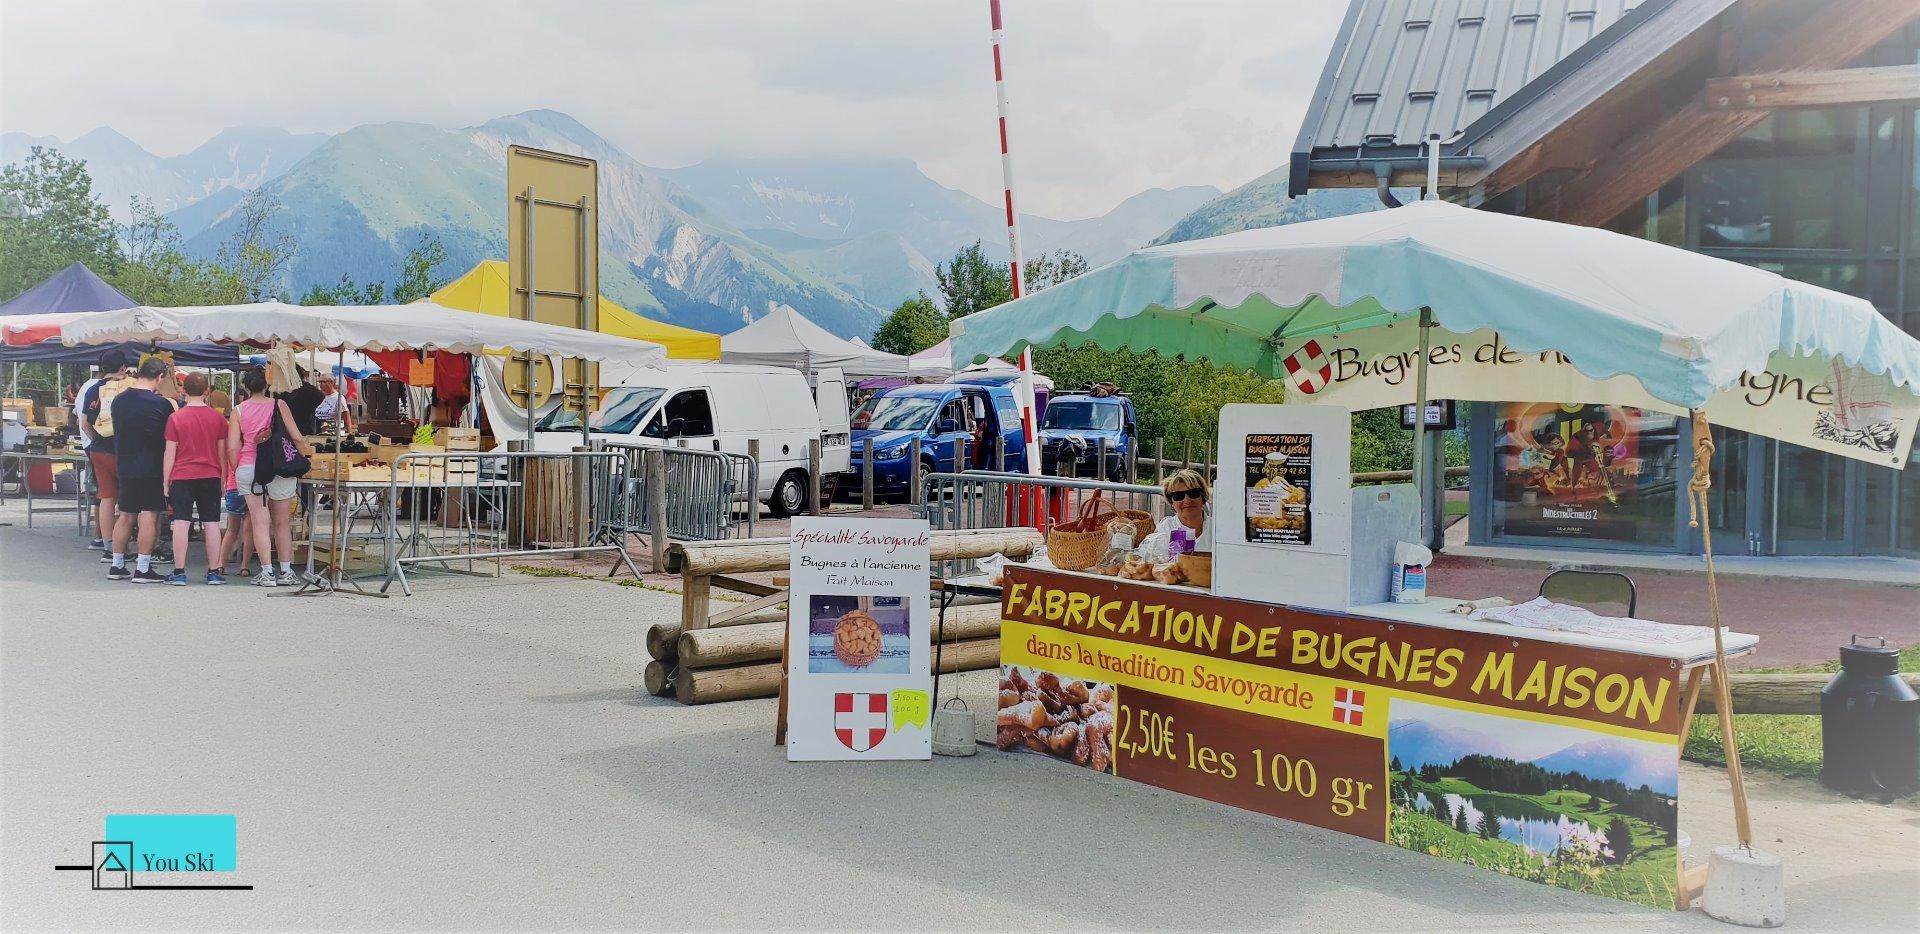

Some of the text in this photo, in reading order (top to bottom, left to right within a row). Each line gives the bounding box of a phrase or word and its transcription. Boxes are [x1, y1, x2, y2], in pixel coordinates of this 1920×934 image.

[1331, 343, 1461, 385] Bugnes
[1474, 332, 1522, 365] de
[1246, 436, 1310, 444] FABRICATION DE
[1248, 446, 1309, 454] BUGNES MAISON
[1542, 507, 1598, 520] INDESTRUCTIBLES 2
[792, 528, 929, 554] Spécialité Savoyarde
[800, 556, 921, 571] Bugnes à l'ancienne
[826, 574, 894, 587] Fait Maison
[1006, 583, 1670, 724] FABRICATION DE BUGNES MAISON
[1026, 634, 1314, 710] dans la tradition Savoyarde
[1118, 704, 1373, 817] 2,50€ les 100 gr
